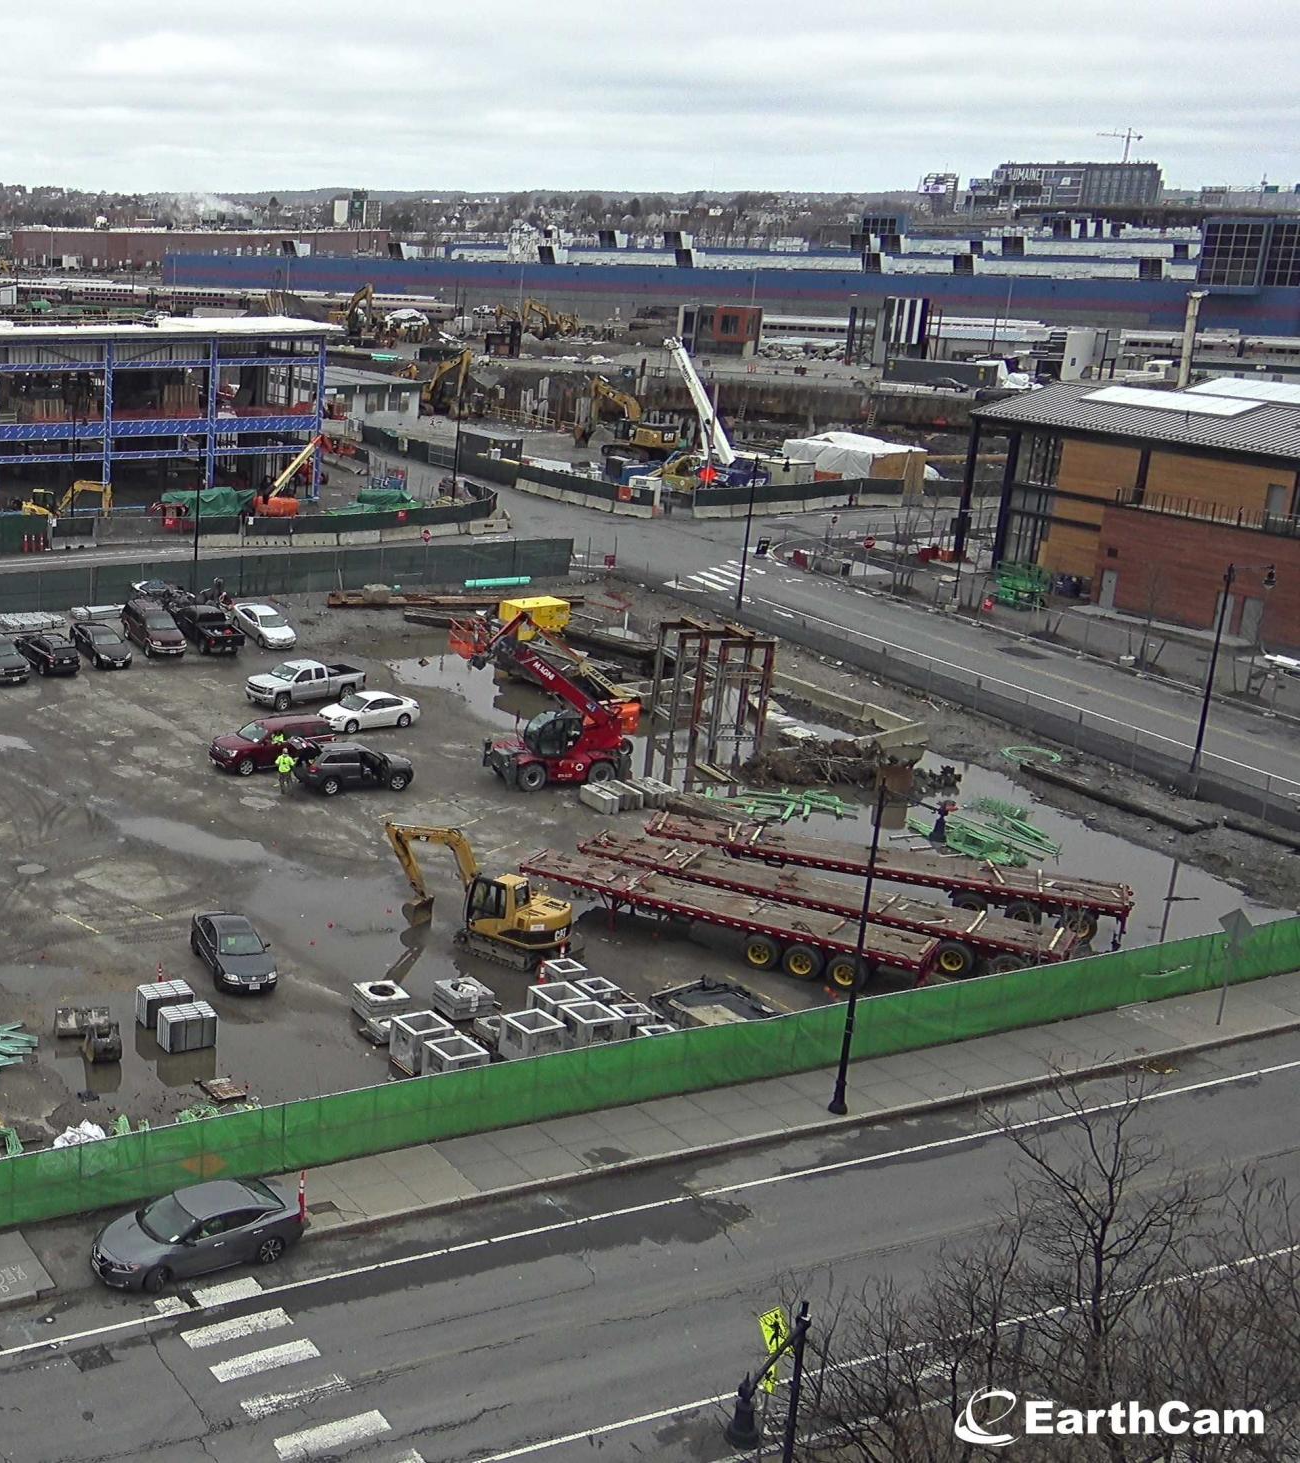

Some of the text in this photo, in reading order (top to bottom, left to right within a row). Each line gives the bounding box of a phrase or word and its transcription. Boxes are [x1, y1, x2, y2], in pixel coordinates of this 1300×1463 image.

[664, 433, 674, 442] CAT
[533, 661, 555, 680] MAGNI
[555, 928, 567, 941] CAT
